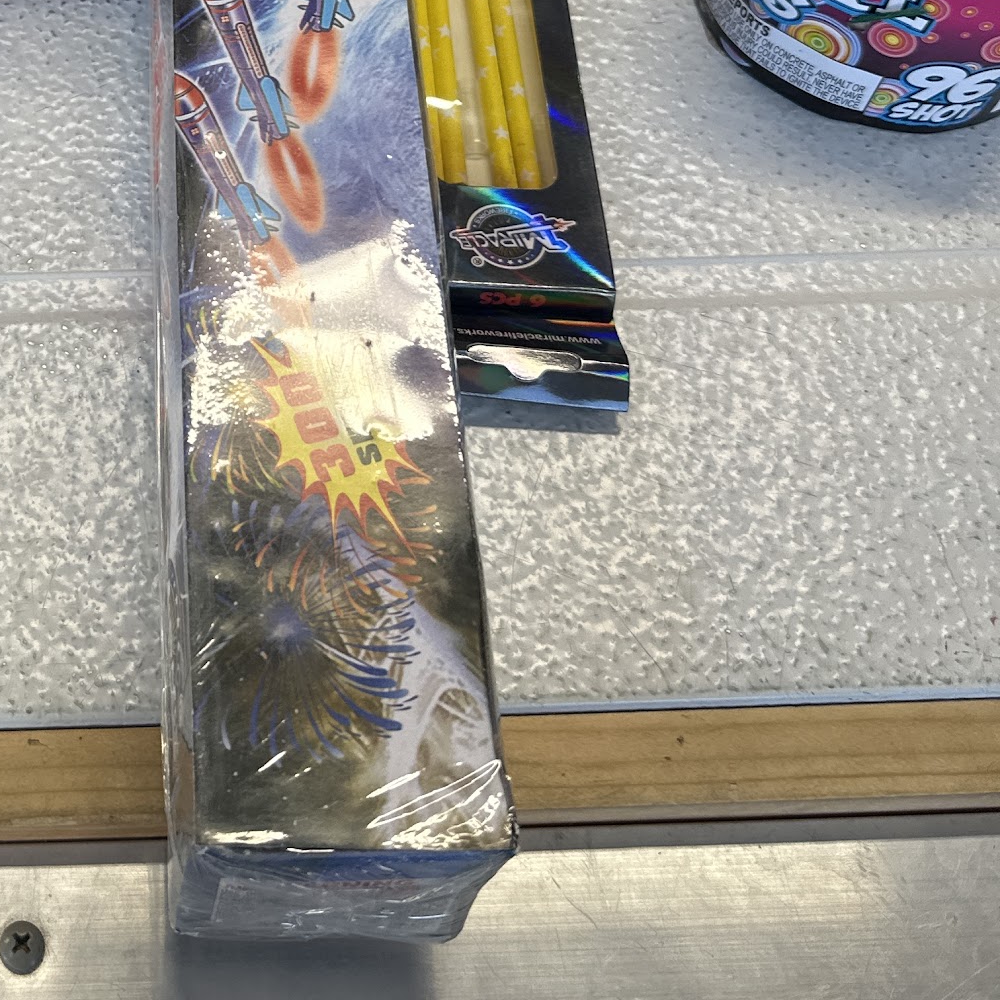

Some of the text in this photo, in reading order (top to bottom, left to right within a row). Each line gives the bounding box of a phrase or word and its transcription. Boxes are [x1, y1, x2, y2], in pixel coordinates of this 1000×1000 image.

[755, 53, 777, 72] FAILS
[776, 66, 787, 77] TO
[786, 72, 813, 91] IGNITE
[813, 84, 830, 99] THE
[829, 91, 861, 110] DEVICE.
[757, 47, 783, 66] COULD
[812, 77, 841, 94] NEVER
[840, 88, 865, 101] HAVE
[762, 37, 774, 49] ON
[815, 70, 853, 89] ASPHALT
[851, 83, 867, 94] OR
[905, 65, 1000, 104] 96
[891, 100, 983, 124] SHOT
[456, 230, 571, 253] MIRACLE
[479, 291, 547, 308] 6 PCS
[278, 371, 356, 484] 300
